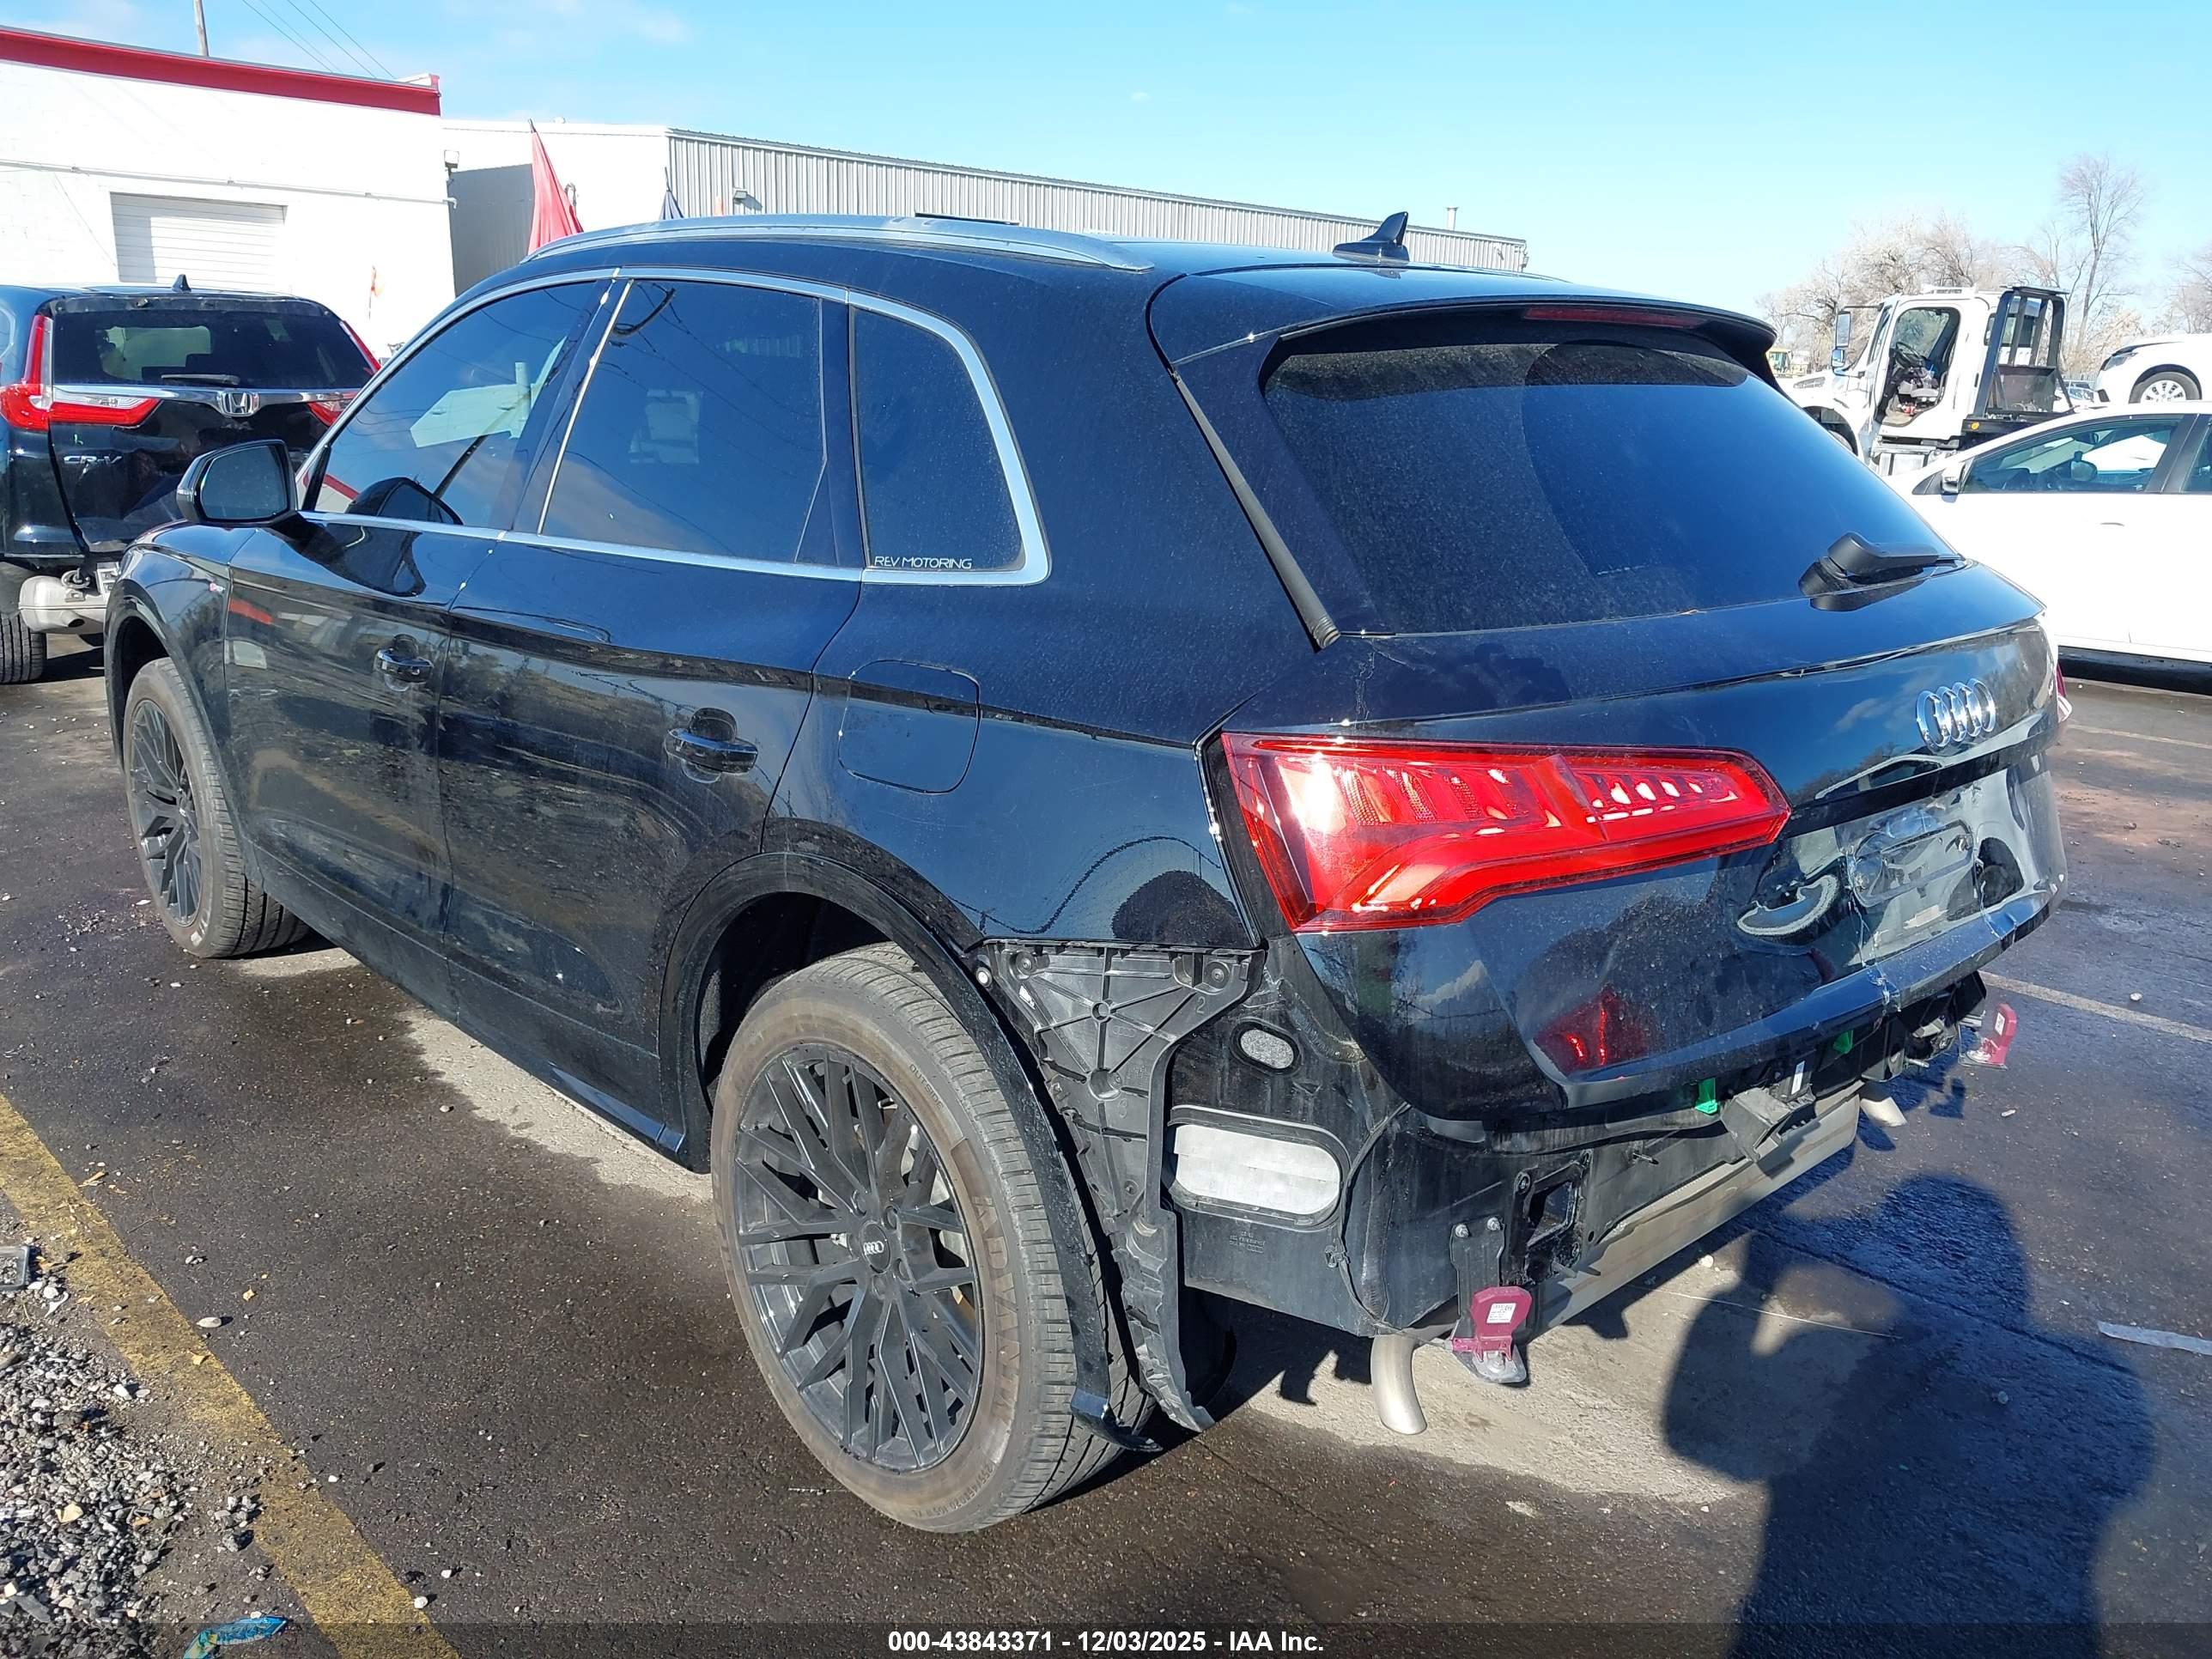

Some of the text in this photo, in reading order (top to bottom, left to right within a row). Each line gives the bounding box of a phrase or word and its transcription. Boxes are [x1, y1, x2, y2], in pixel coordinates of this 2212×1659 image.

[64, 455, 122, 465] CR-V
[874, 556, 972, 569] REV MOTORING
[908, 1063, 944, 1110] OUTSIDE
